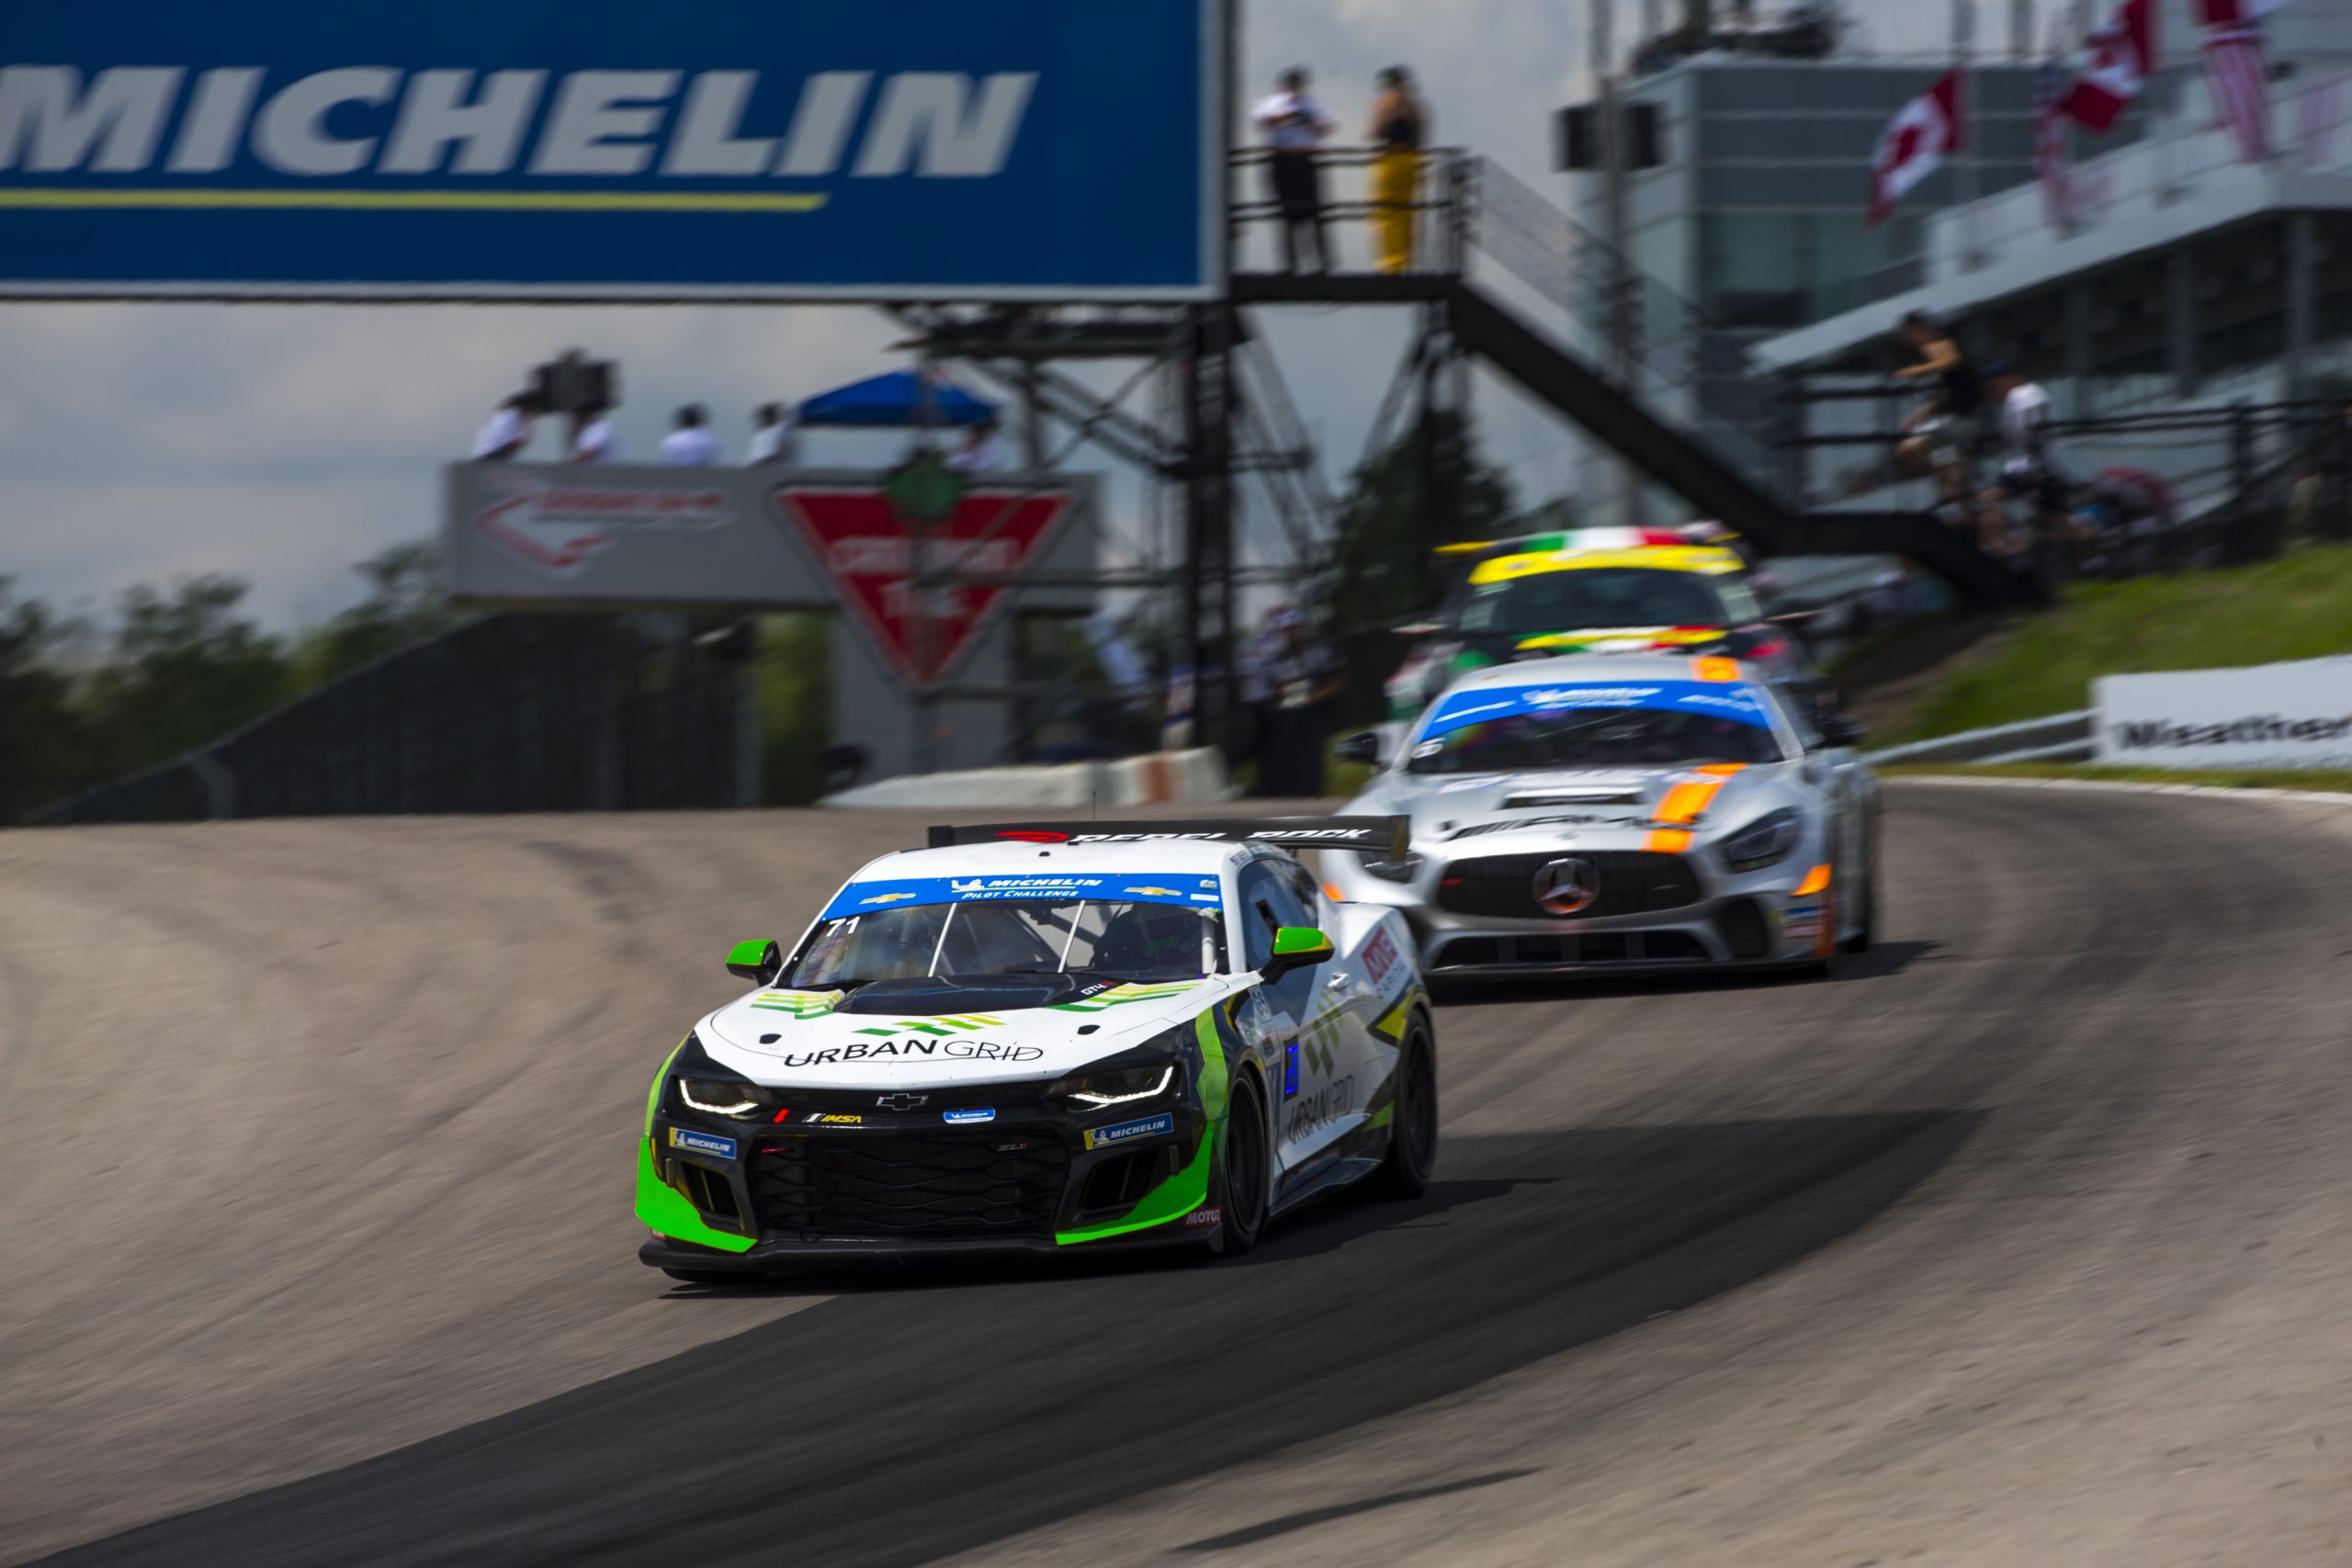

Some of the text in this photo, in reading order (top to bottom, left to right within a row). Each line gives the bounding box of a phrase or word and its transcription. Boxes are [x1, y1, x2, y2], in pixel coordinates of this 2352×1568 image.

[0, 65, 1040, 177] MICHELIN
[988, 878, 1102, 888] MICHELIN
[961, 889, 1080, 900] PILOT CHALLENGE
[825, 916, 861, 938] 71
[820, 1114, 862, 1123] IMSA
[1110, 1120, 1166, 1139] MICHELIN
[686, 1137, 731, 1152] MICHELIN
